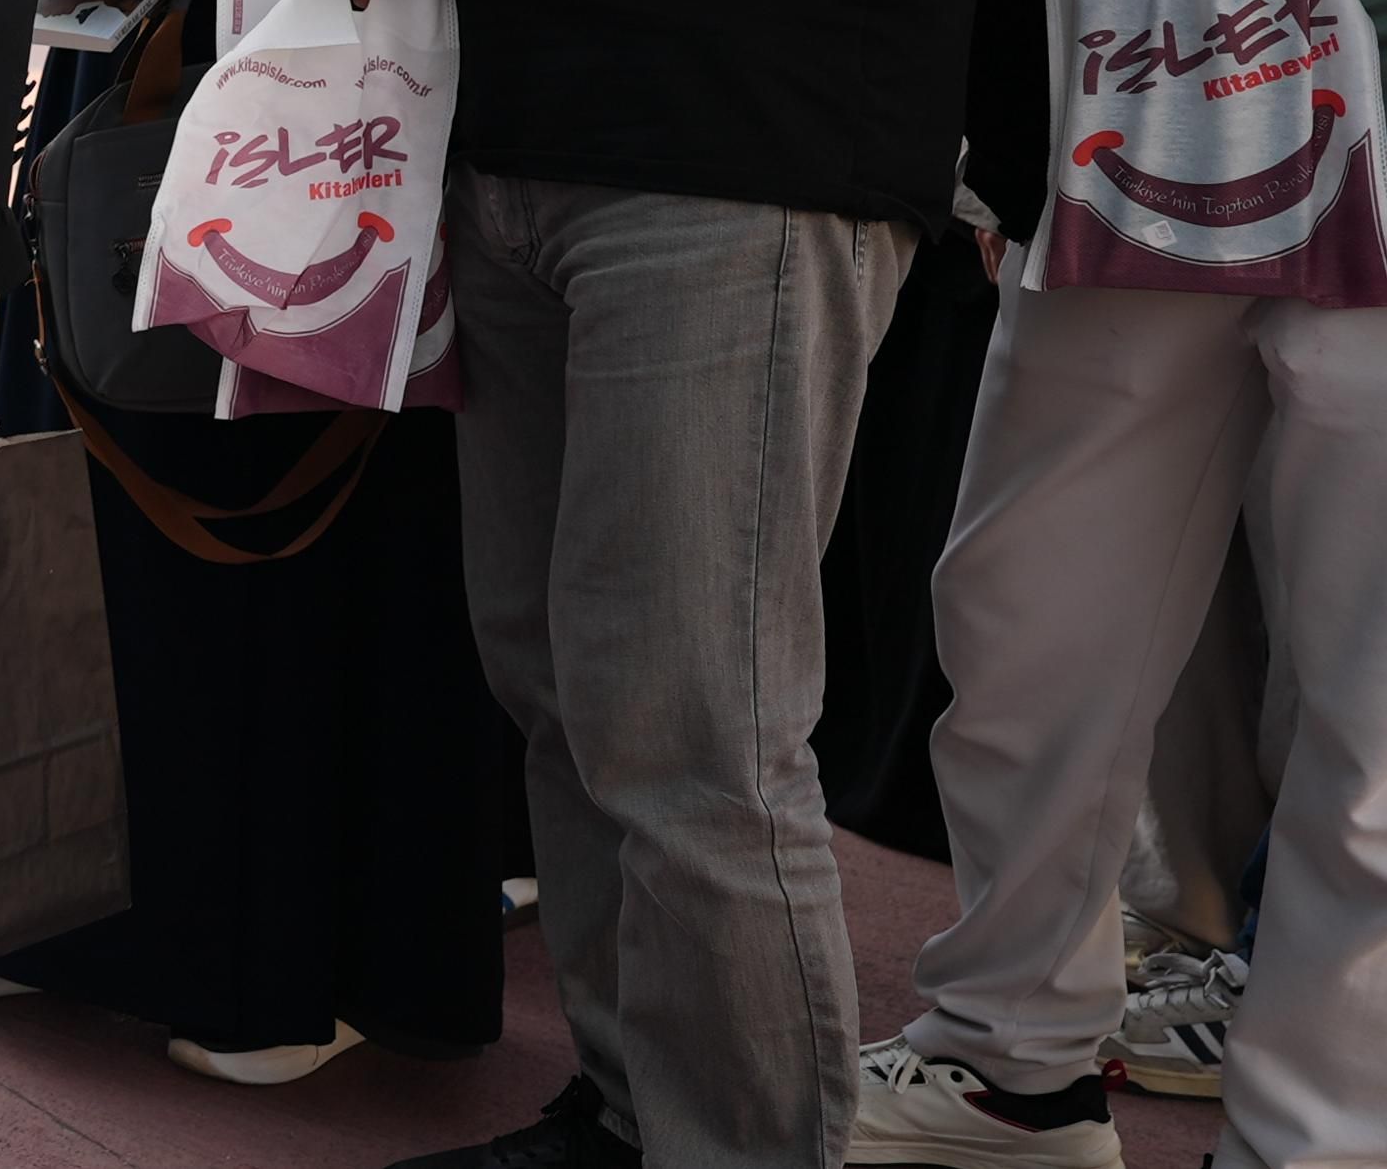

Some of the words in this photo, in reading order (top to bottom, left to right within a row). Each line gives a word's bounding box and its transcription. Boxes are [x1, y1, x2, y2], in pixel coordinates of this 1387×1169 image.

[215, 56, 327, 90] www.kitapisler.com
[1203, 33, 1340, 101] Kitabeveri
[1202, 194, 1264, 221] Toptan
